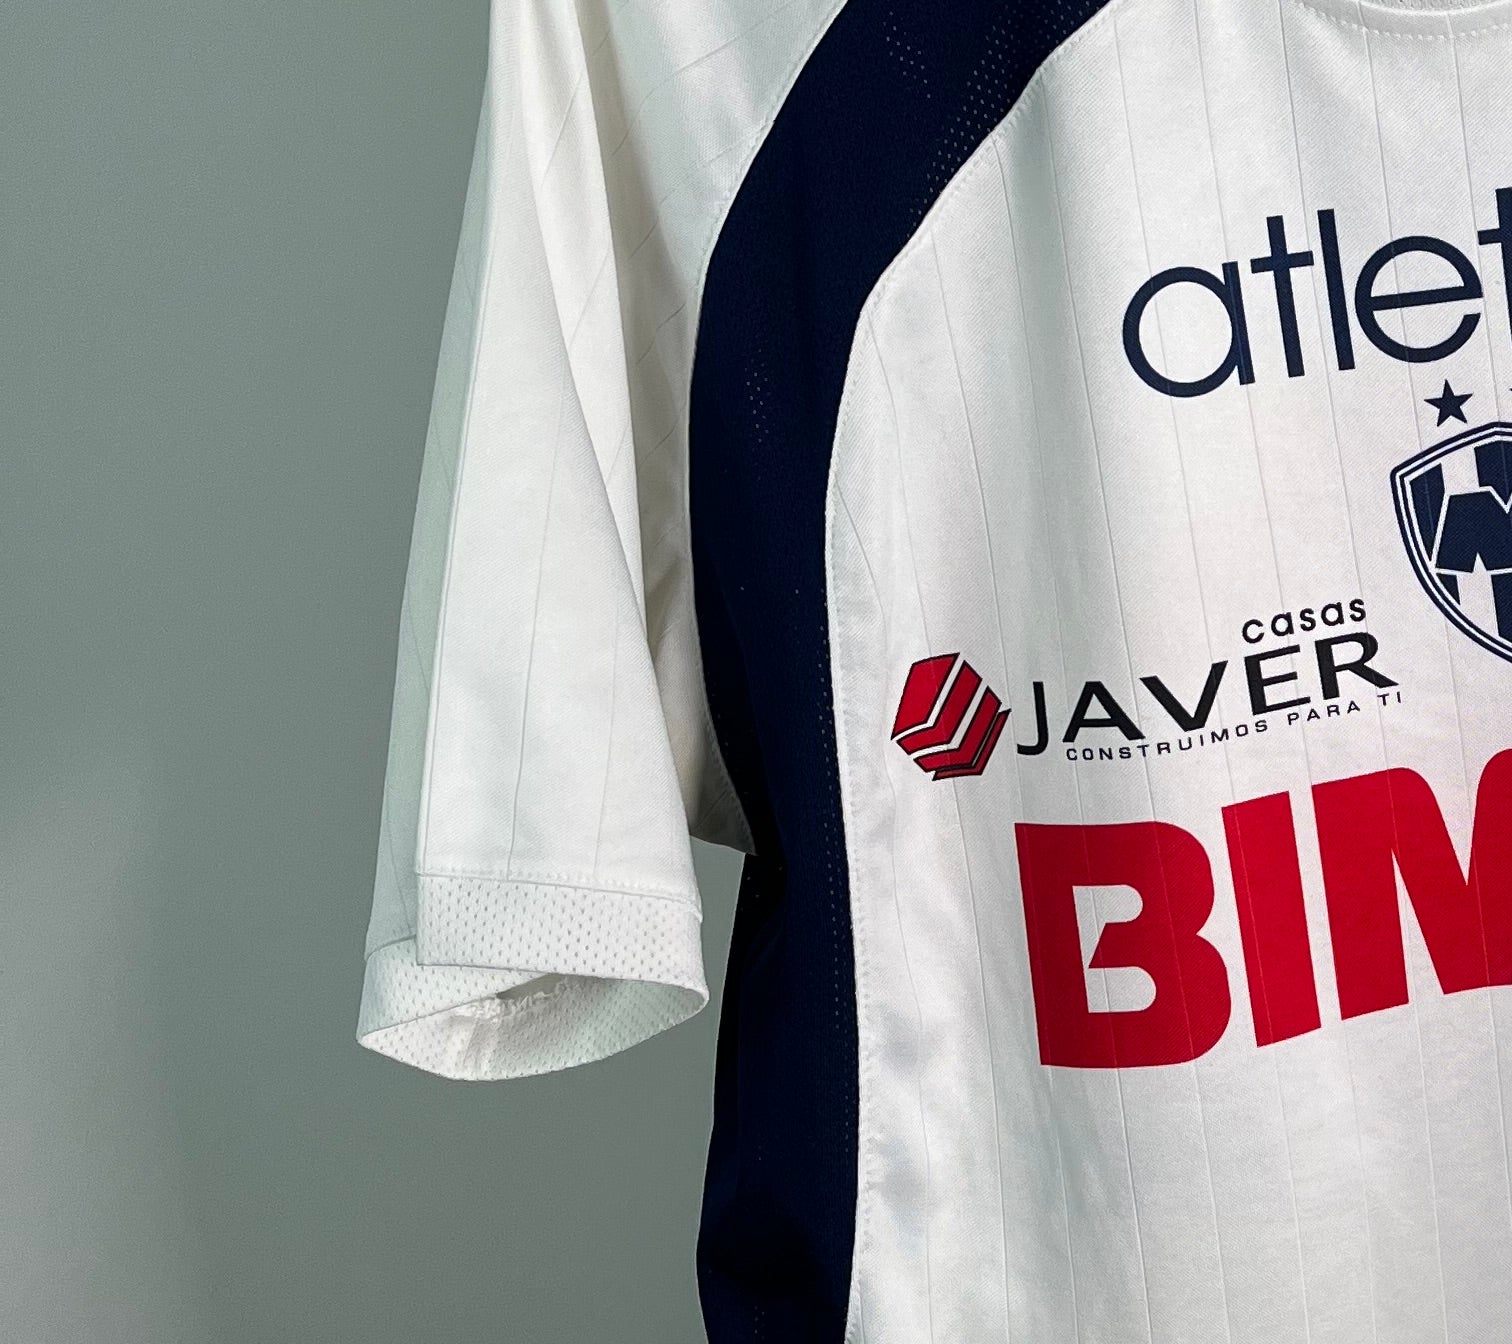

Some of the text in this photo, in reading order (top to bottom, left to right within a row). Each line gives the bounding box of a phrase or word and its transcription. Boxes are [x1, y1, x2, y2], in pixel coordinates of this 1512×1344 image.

[1242, 598, 1367, 644] casas
[1016, 632, 1400, 756] JAVER
[1066, 691, 1402, 761] CONSTRUIMOS PARA TI
